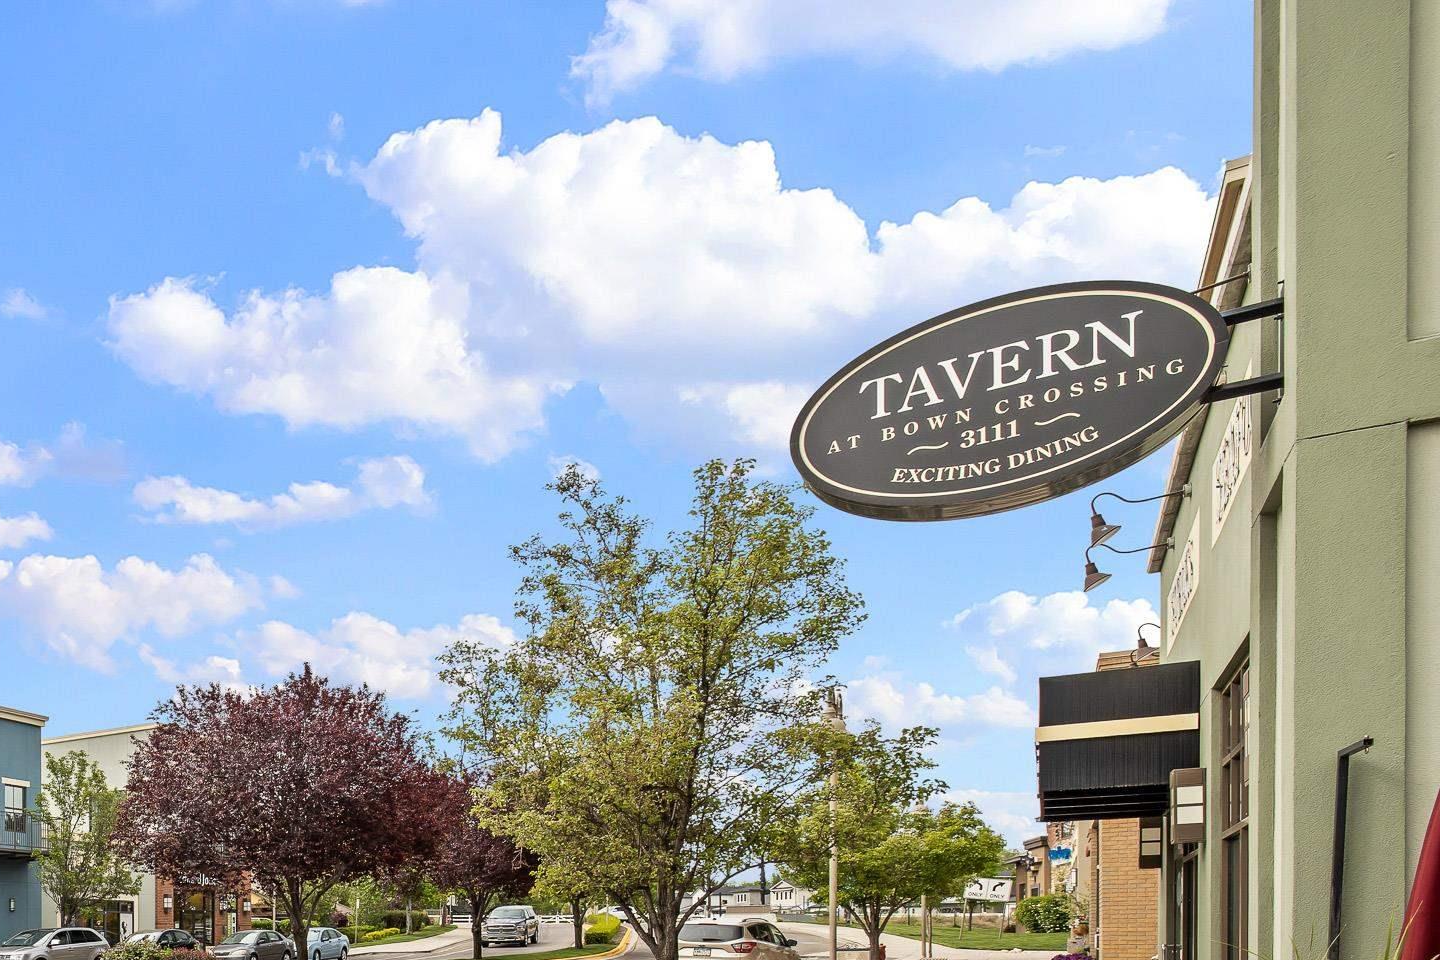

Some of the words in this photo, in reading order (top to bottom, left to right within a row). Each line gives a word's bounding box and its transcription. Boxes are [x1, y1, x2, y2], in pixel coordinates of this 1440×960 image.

[858, 309, 1144, 420] TAVERN
[826, 434, 861, 455] AT
[880, 407, 972, 442] BOWN
[994, 357, 1185, 414] CROSSING
[960, 420, 1022, 449] 3111
[890, 458, 1002, 483] EXCITING
[1007, 425, 1099, 470] DINING
